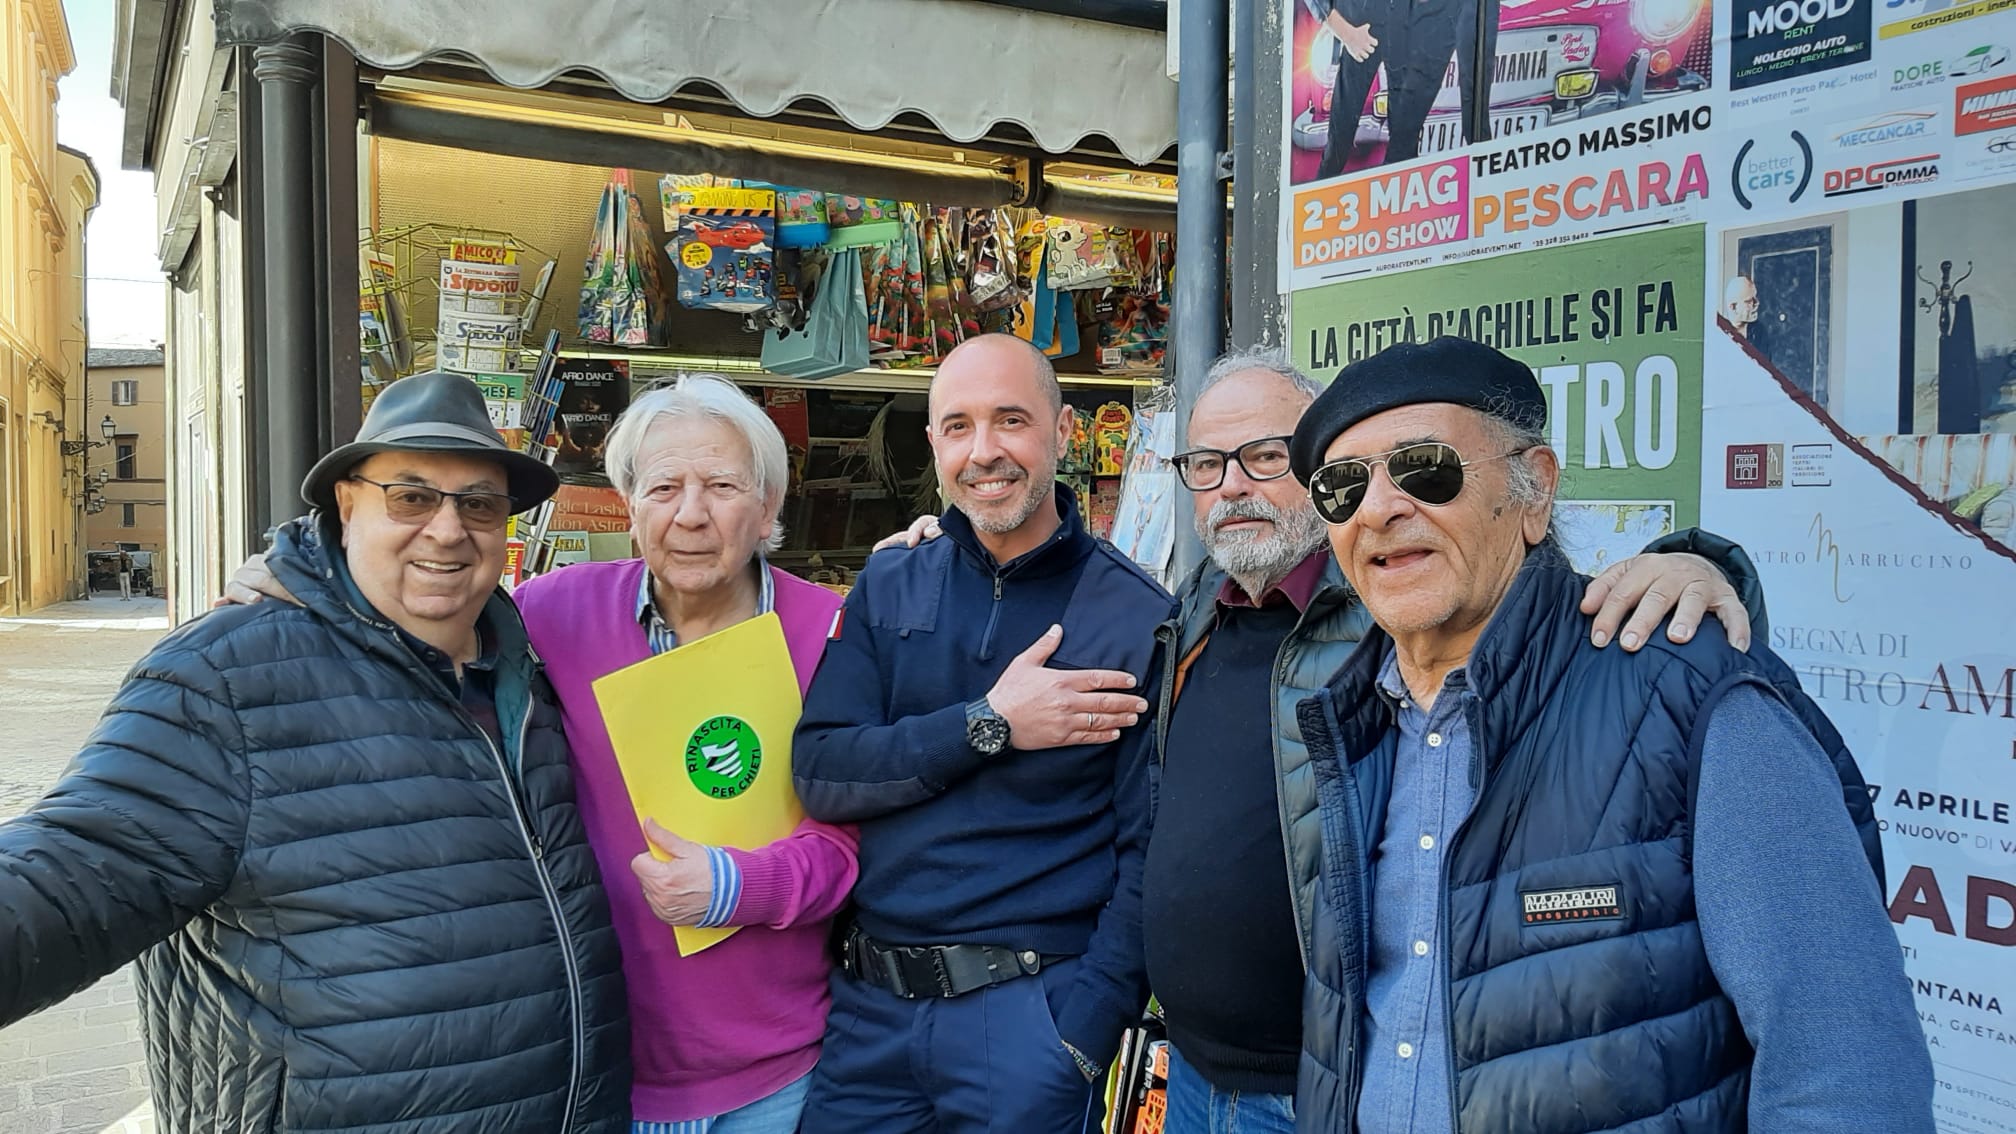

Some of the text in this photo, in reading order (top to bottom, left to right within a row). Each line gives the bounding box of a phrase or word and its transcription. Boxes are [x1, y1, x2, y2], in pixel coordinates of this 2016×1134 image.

[1748, 0, 1855, 38] MOOD
[1784, 24, 1816, 40] RENT
[1911, 8, 1975, 30] costruzioni
[1752, 35, 1847, 66] NOLEGGIO AUTO
[1768, 59, 1795, 71] MEDIO
[1893, 61, 1944, 84] DORE
[1730, 98, 1750, 110] Best
[1751, 90, 1788, 105] Western
[1850, 69, 1878, 83] Hotel
[1473, 105, 1711, 178] TEATRO MASSIMO
[1839, 121, 1926, 148] MECCANCAR
[1748, 154, 1796, 173] better
[1748, 168, 1796, 191] cars
[1303, 164, 1460, 232] 2-3 MAG
[1473, 153, 1711, 239] PESCARA
[454, 243, 494, 259] AMICO
[1300, 213, 1462, 266] DOPPIO SHOW
[1310, 327, 1339, 370] LA
[1591, 286, 1622, 340] SI
[1636, 280, 1678, 335] FA
[561, 371, 616, 381] AFRO DANCE
[584, 413, 609, 422] DANCE
[1532, 354, 1679, 471] TRO
[549, 517, 581, 531] tion
[1752, 550, 1807, 564] ATRO
[1771, 625, 1910, 658] SEGNA DI
[1806, 663, 1907, 708] TRO
[687, 718, 742, 774] RINASCITA
[711, 748, 761, 798] PER CHIETI
[1893, 788, 2010, 825] APRILE
[1975, 835, 1994, 851] DI
[1902, 945, 1918, 960] TI
